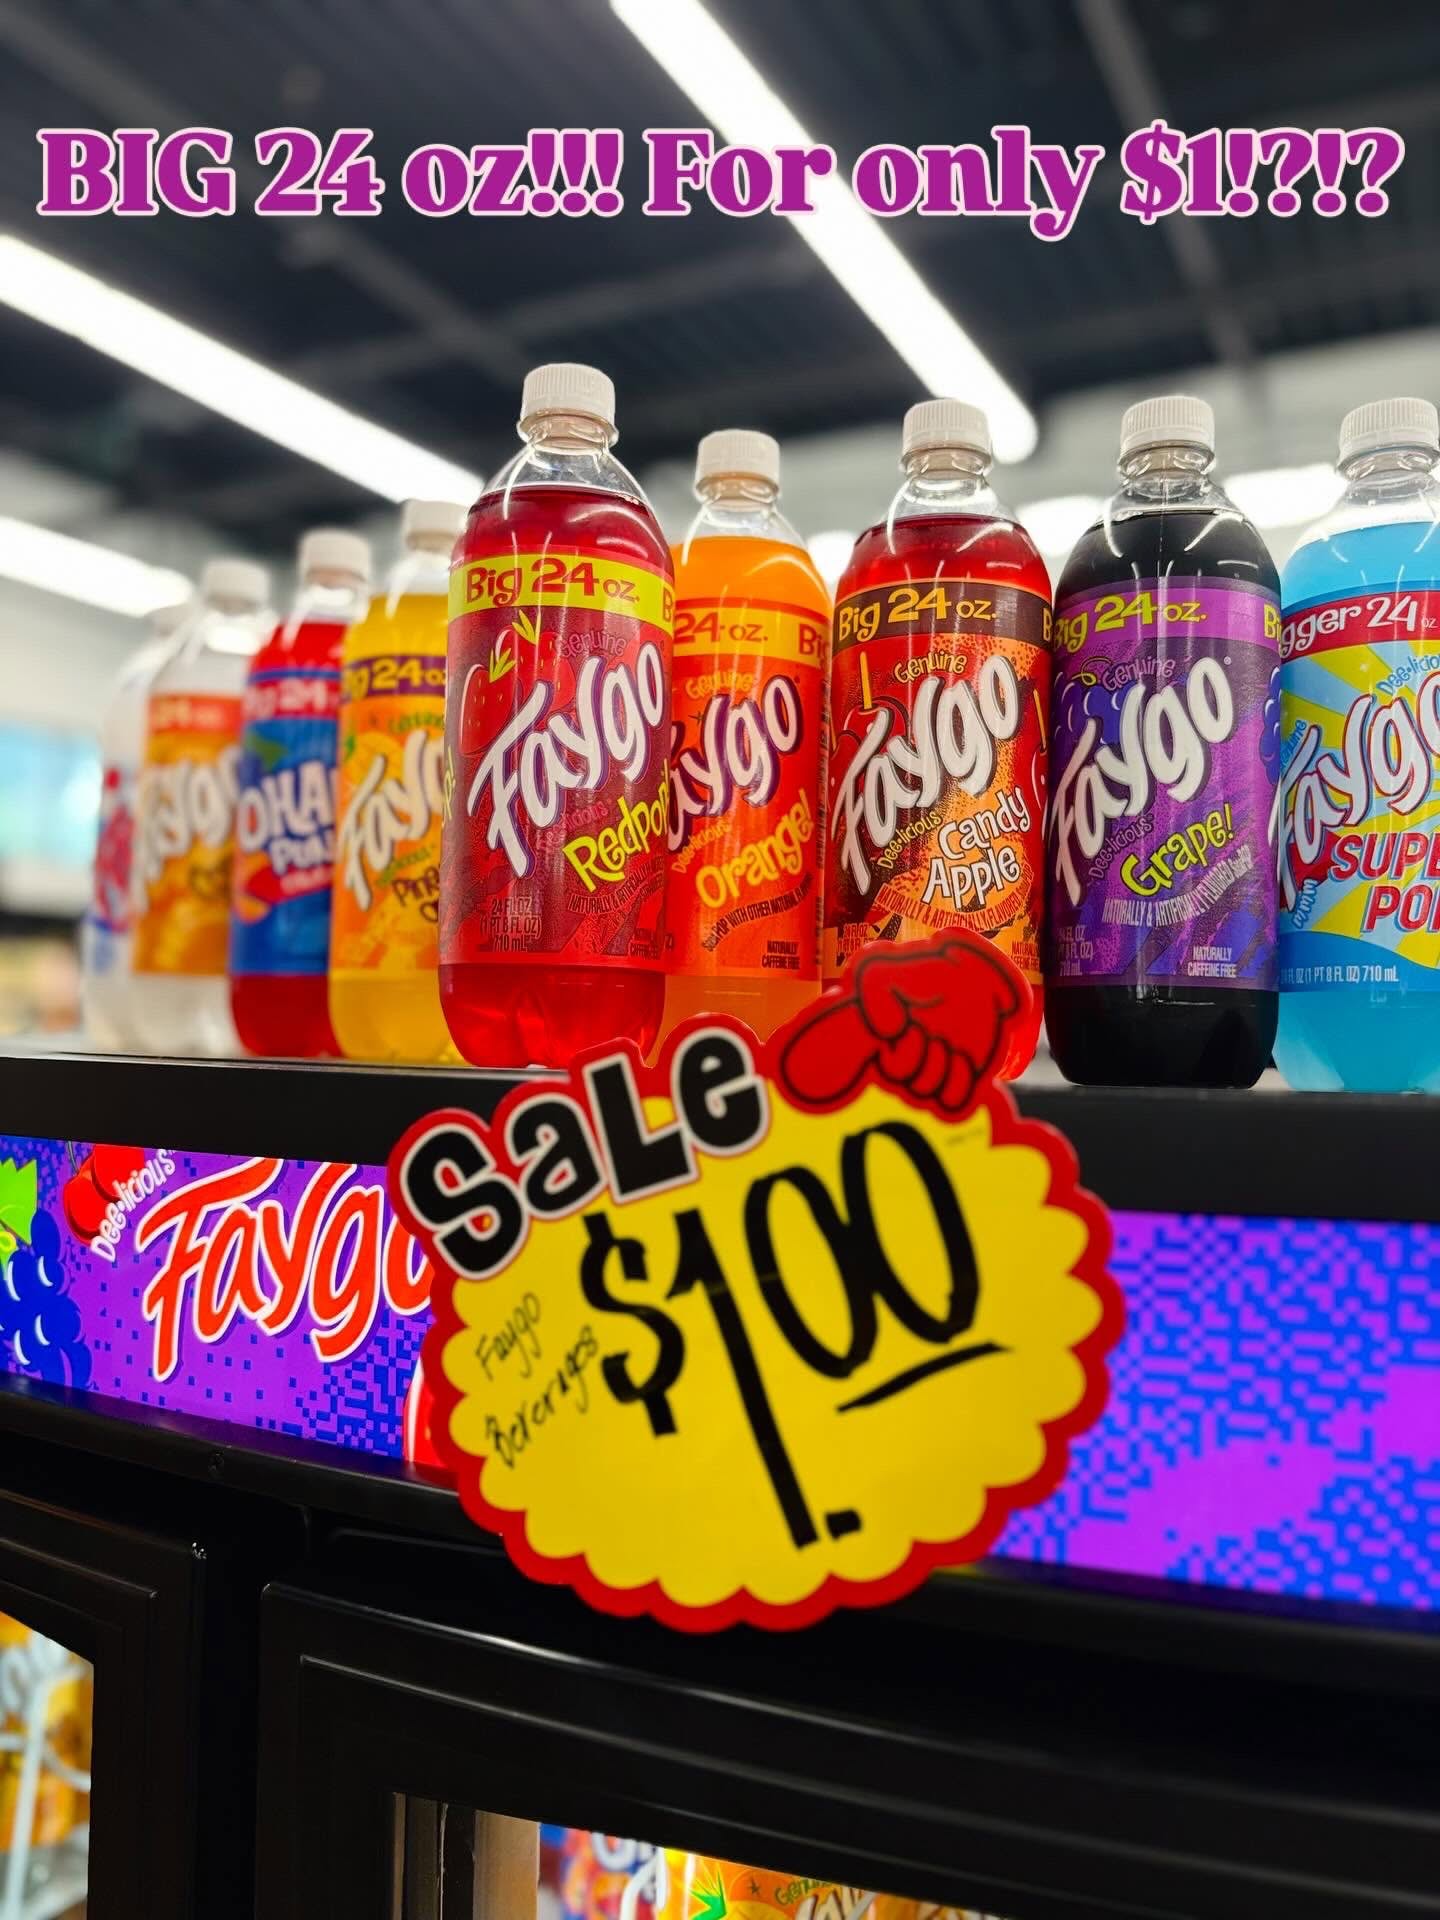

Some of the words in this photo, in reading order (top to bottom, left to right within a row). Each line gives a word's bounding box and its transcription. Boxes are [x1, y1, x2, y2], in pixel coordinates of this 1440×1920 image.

[466, 566, 522, 608] Big
[531, 557, 599, 597] 24
[602, 577, 640, 603] oz.
[673, 611, 725, 645] 24
[837, 601, 881, 642] Big
[887, 587, 952, 625] 24
[955, 597, 998, 622] oz.
[1094, 592, 1157, 632] 24
[1163, 602, 1208, 622] oz.
[1366, 594, 1418, 632] 24
[371, 658, 422, 690] 24
[893, 651, 967, 684] Genuine
[1102, 657, 1175, 691] Genuine
[467, 641, 665, 879] Faygo
[670, 673, 801, 852] aygo
[831, 655, 1019, 896] Faygo
[1048, 657, 1234, 906] Faygo
[938, 786, 1031, 860] Candy
[1120, 803, 1234, 897] Grape!
[921, 846, 1021, 911] Apple
[1102, 899, 1146, 926] NATURALLY
[1361, 884, 1440, 933] PO
[1362, 965, 1382, 983] 710
